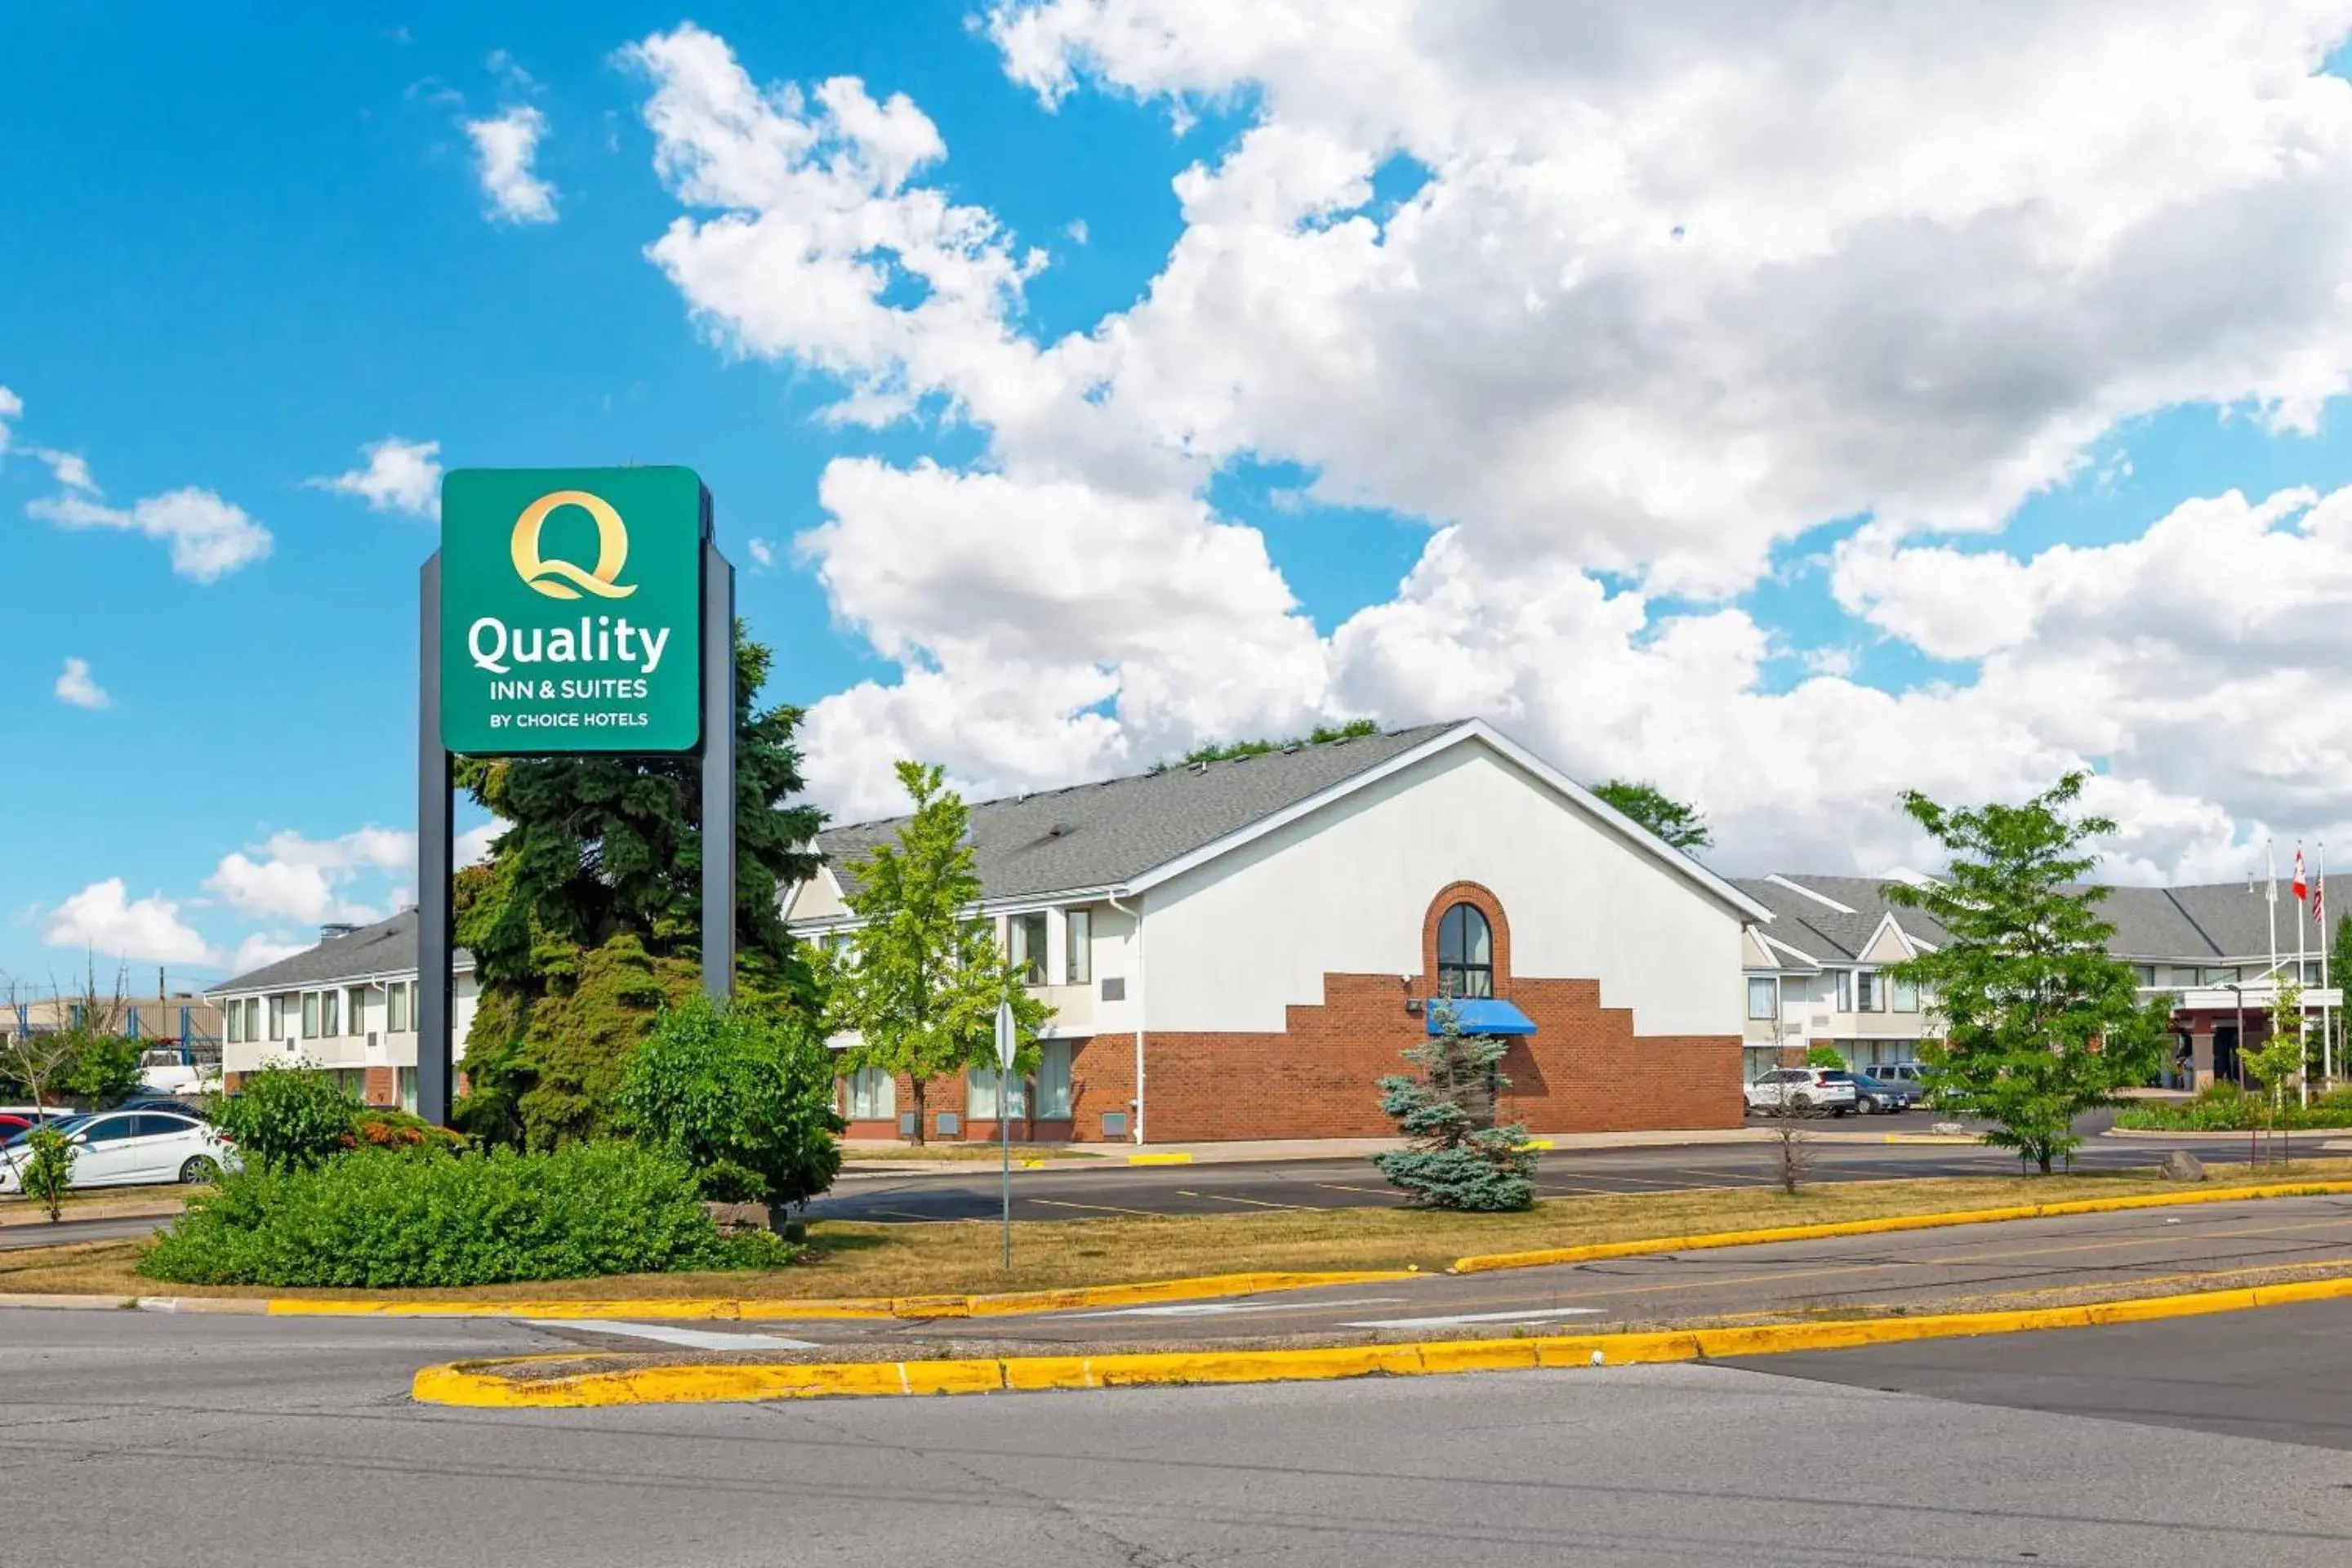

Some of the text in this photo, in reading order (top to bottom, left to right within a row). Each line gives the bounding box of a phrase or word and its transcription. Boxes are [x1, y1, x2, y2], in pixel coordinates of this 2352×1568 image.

[510, 490, 639, 599] Q
[468, 616, 670, 674] Quality
[490, 679, 648, 700] INN & SUITES
[490, 713, 648, 728] BY CHOICE HOTELS
